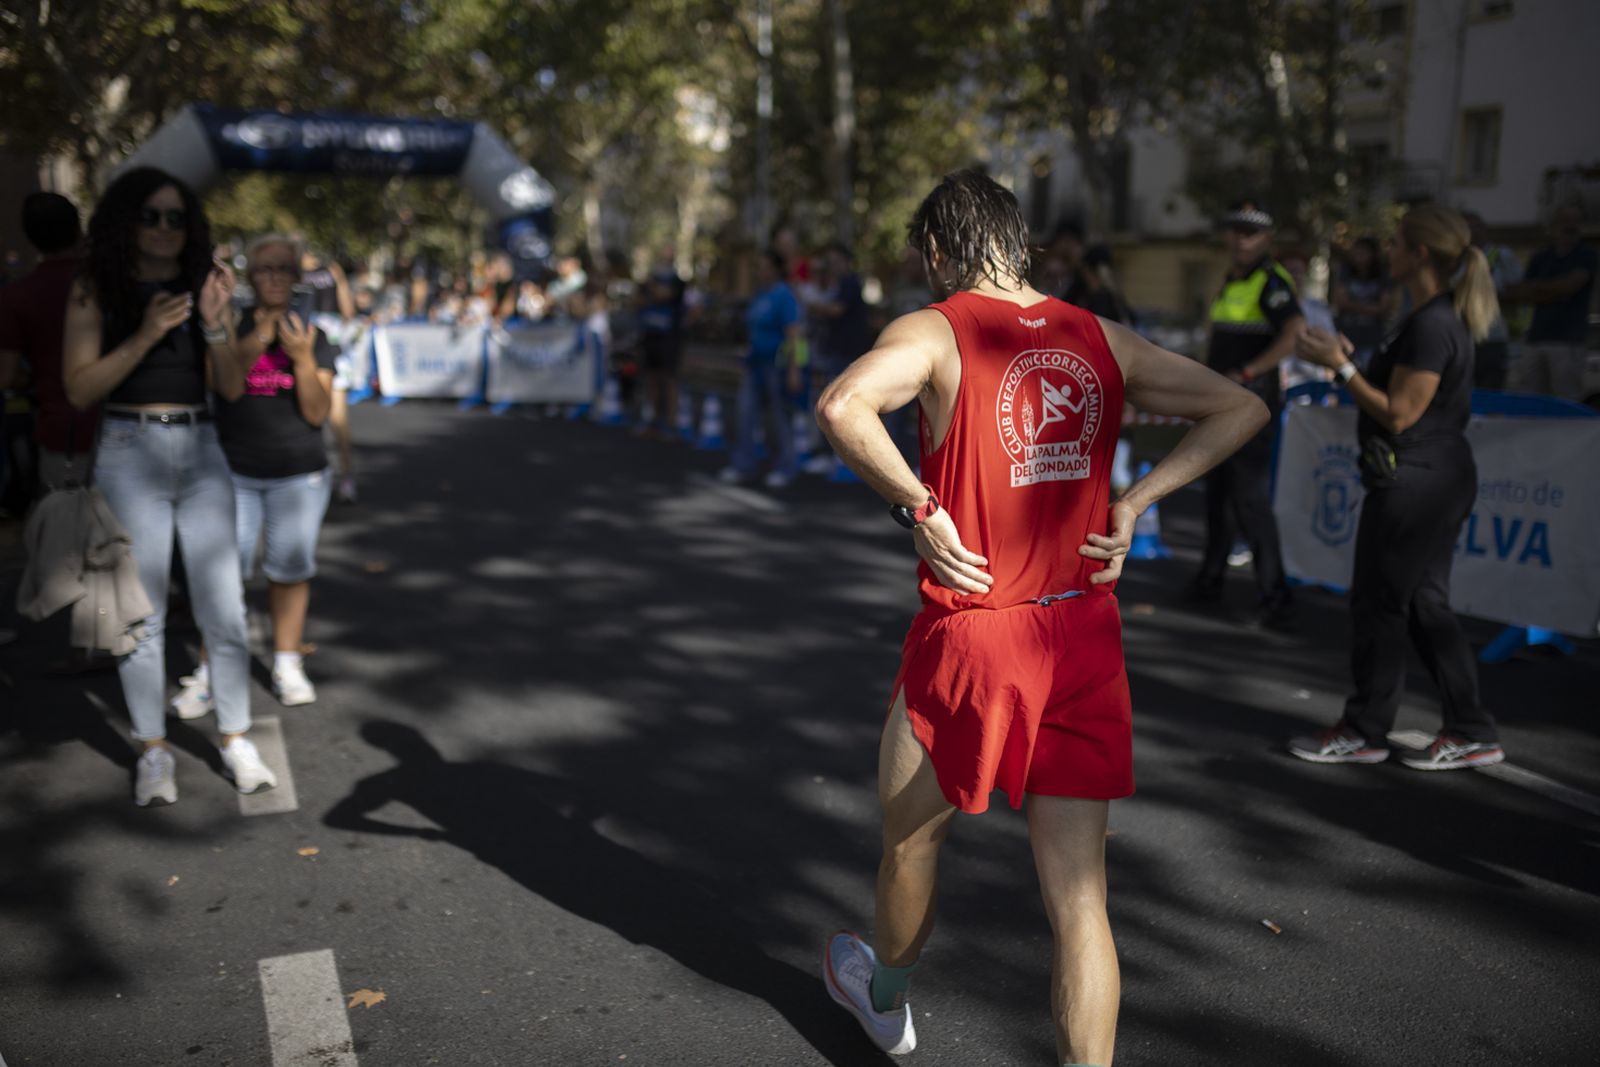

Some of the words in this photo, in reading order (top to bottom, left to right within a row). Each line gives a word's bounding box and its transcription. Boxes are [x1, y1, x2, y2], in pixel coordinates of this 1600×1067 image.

[1002, 416, 1022, 454] CLUB
[1041, 353, 1099, 443] CORRECAMINOS
[1014, 464, 1033, 478] DEL
[1034, 458, 1089, 475] CONDADO
[1478, 479, 1528, 504] ento
[1532, 480, 1565, 508] de
[1456, 512, 1553, 569] LVA
